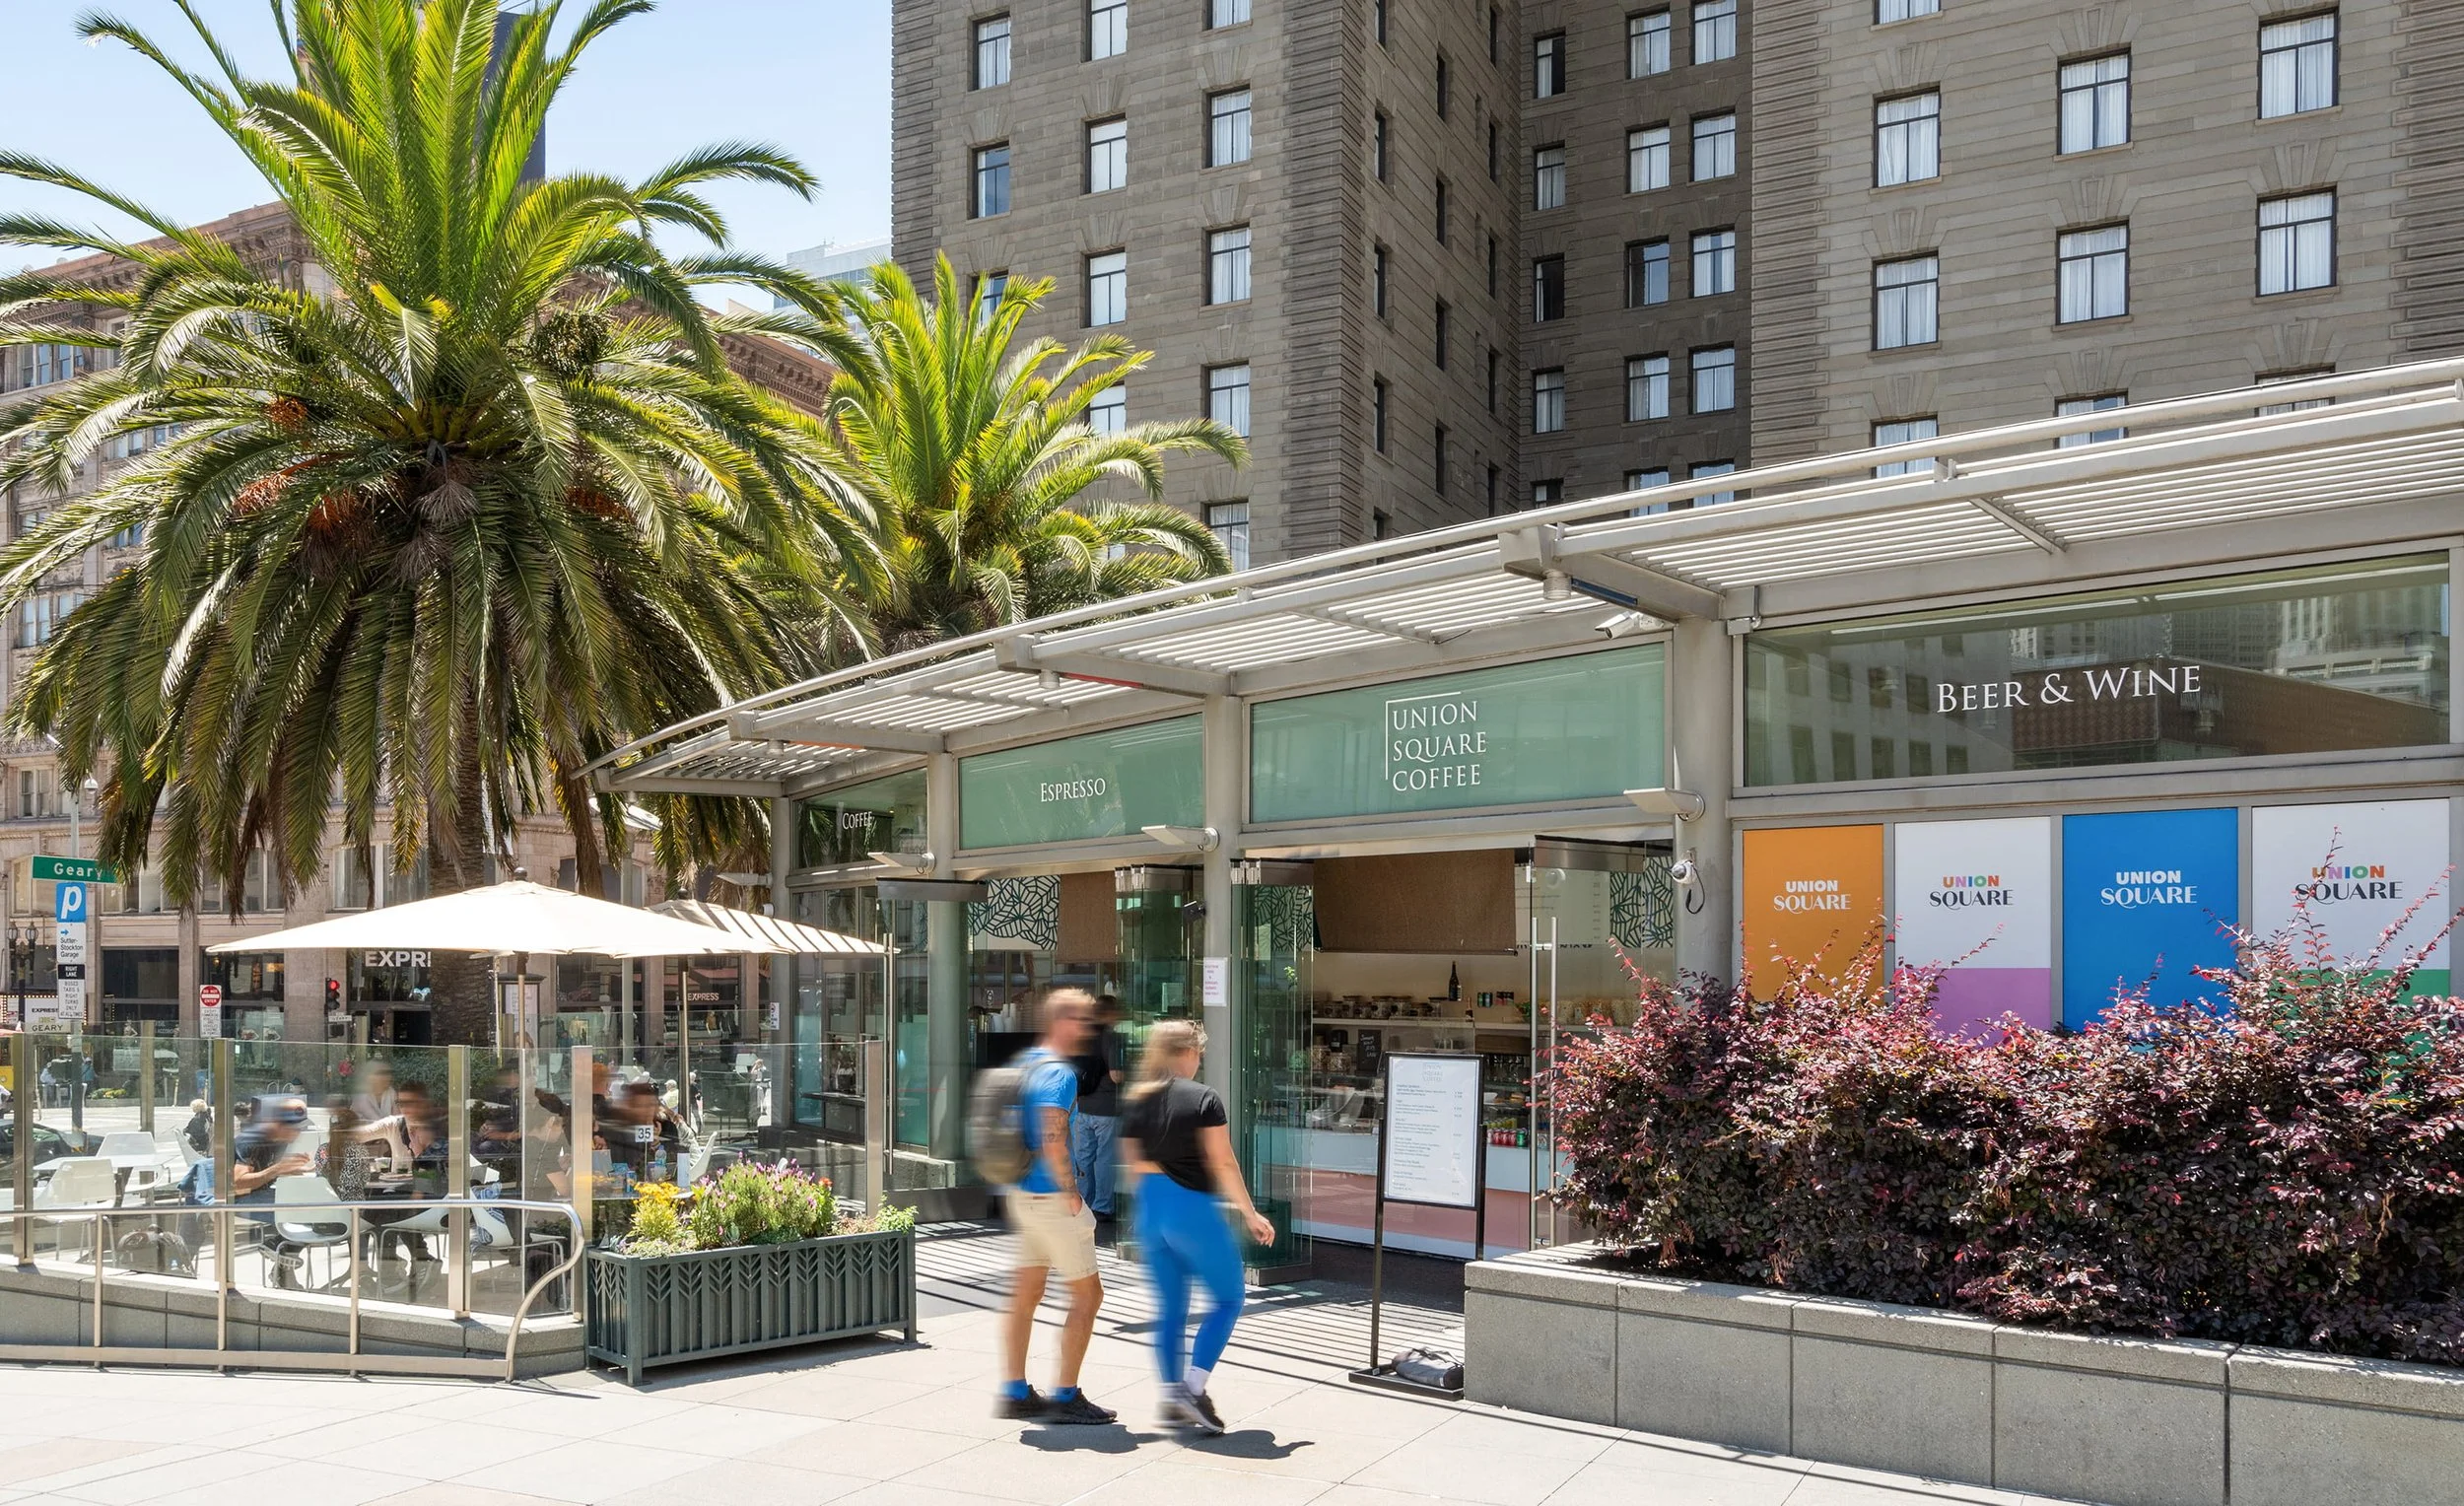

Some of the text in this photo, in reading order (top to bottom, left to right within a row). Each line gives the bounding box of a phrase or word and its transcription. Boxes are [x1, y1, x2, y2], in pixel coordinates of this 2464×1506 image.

[1937, 665, 2202, 714] BEER & WINE
[1393, 701, 1477, 730] UNION
[1393, 732, 1487, 763] SQUARE
[1393, 764, 1481, 791] COFFEE
[1041, 778, 1106, 802] ESPRESSO
[53, 862, 103, 880] Geary
[1943, 875, 2000, 888] UNION
[2116, 870, 2181, 885] UNION
[2311, 865, 2385, 880] UNION
[1785, 880, 1838, 893] UNION
[2100, 886, 2197, 909] SQUARE
[1773, 893, 1851, 915] SQUARE
[1929, 889, 2014, 911] SQUARE
[687, 993, 719, 1001] EXPRESS
[638, 1128, 651, 1139] 35
